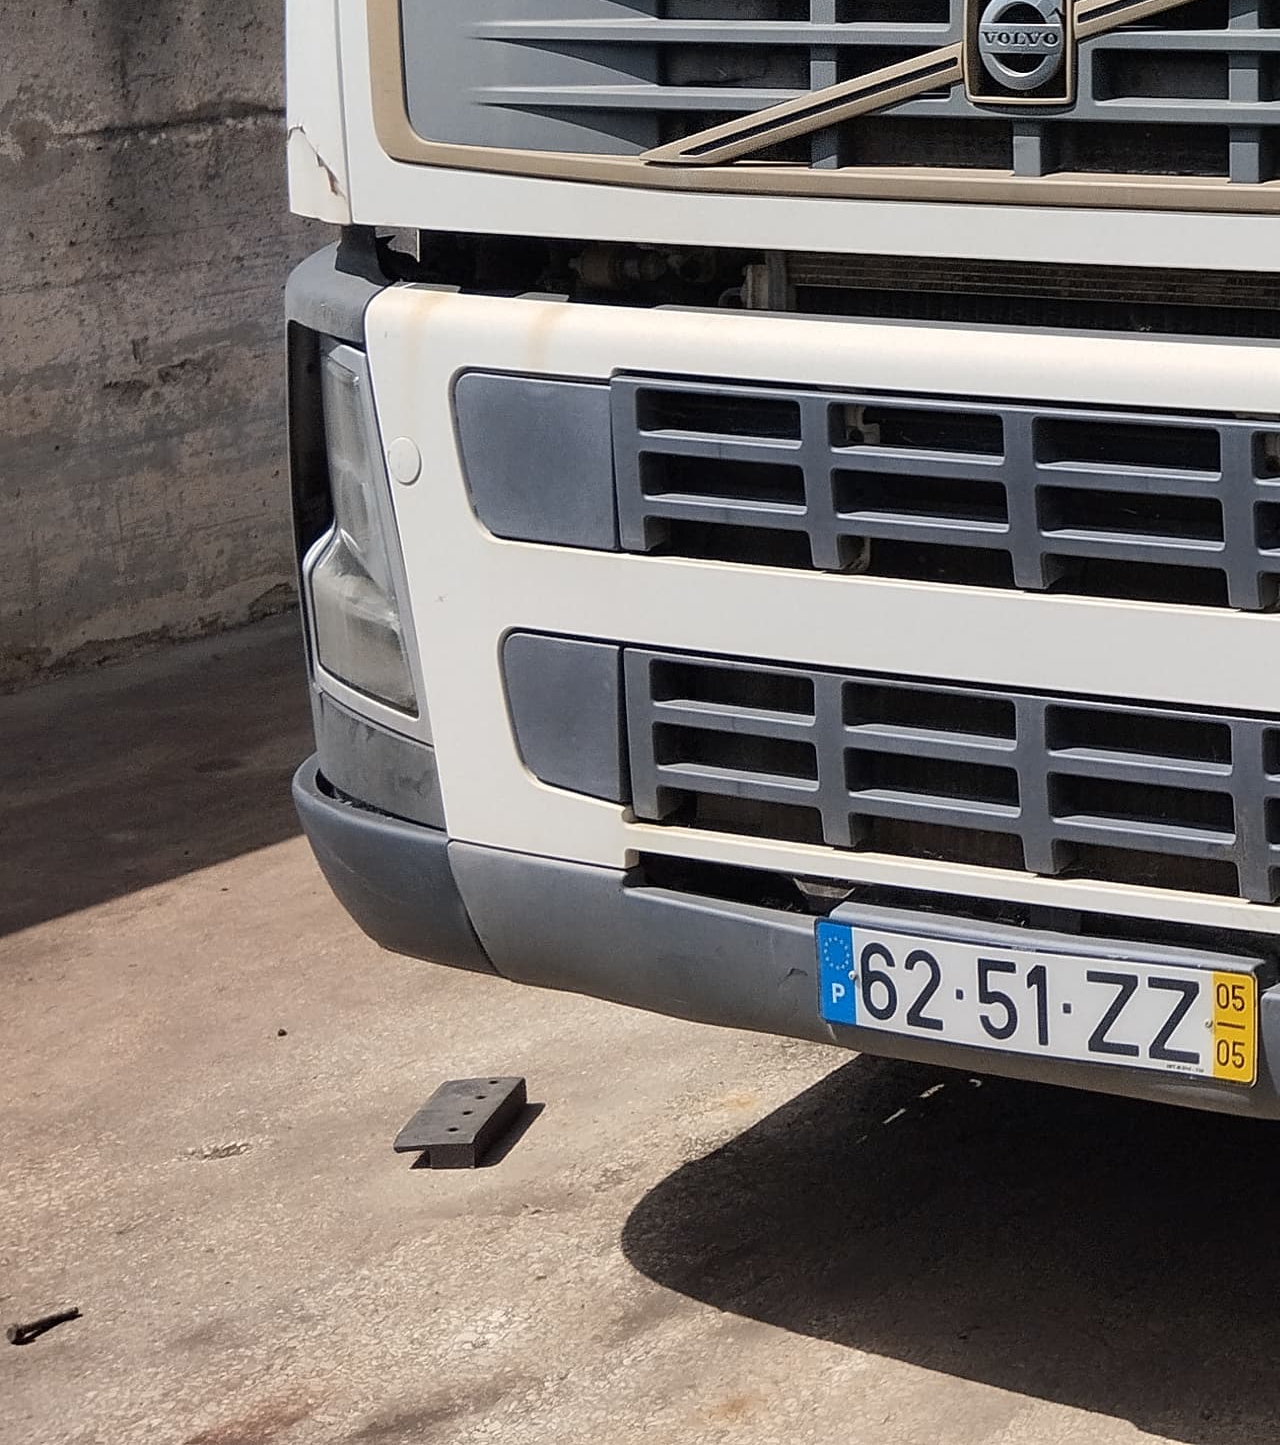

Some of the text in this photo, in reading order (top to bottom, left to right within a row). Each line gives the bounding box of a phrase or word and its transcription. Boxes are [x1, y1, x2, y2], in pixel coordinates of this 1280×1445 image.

[982, 31, 1059, 46] VOLVO
[832, 985, 845, 1004] P
[1216, 982, 1246, 1013] 05
[1216, 1039, 1246, 1070] 05
